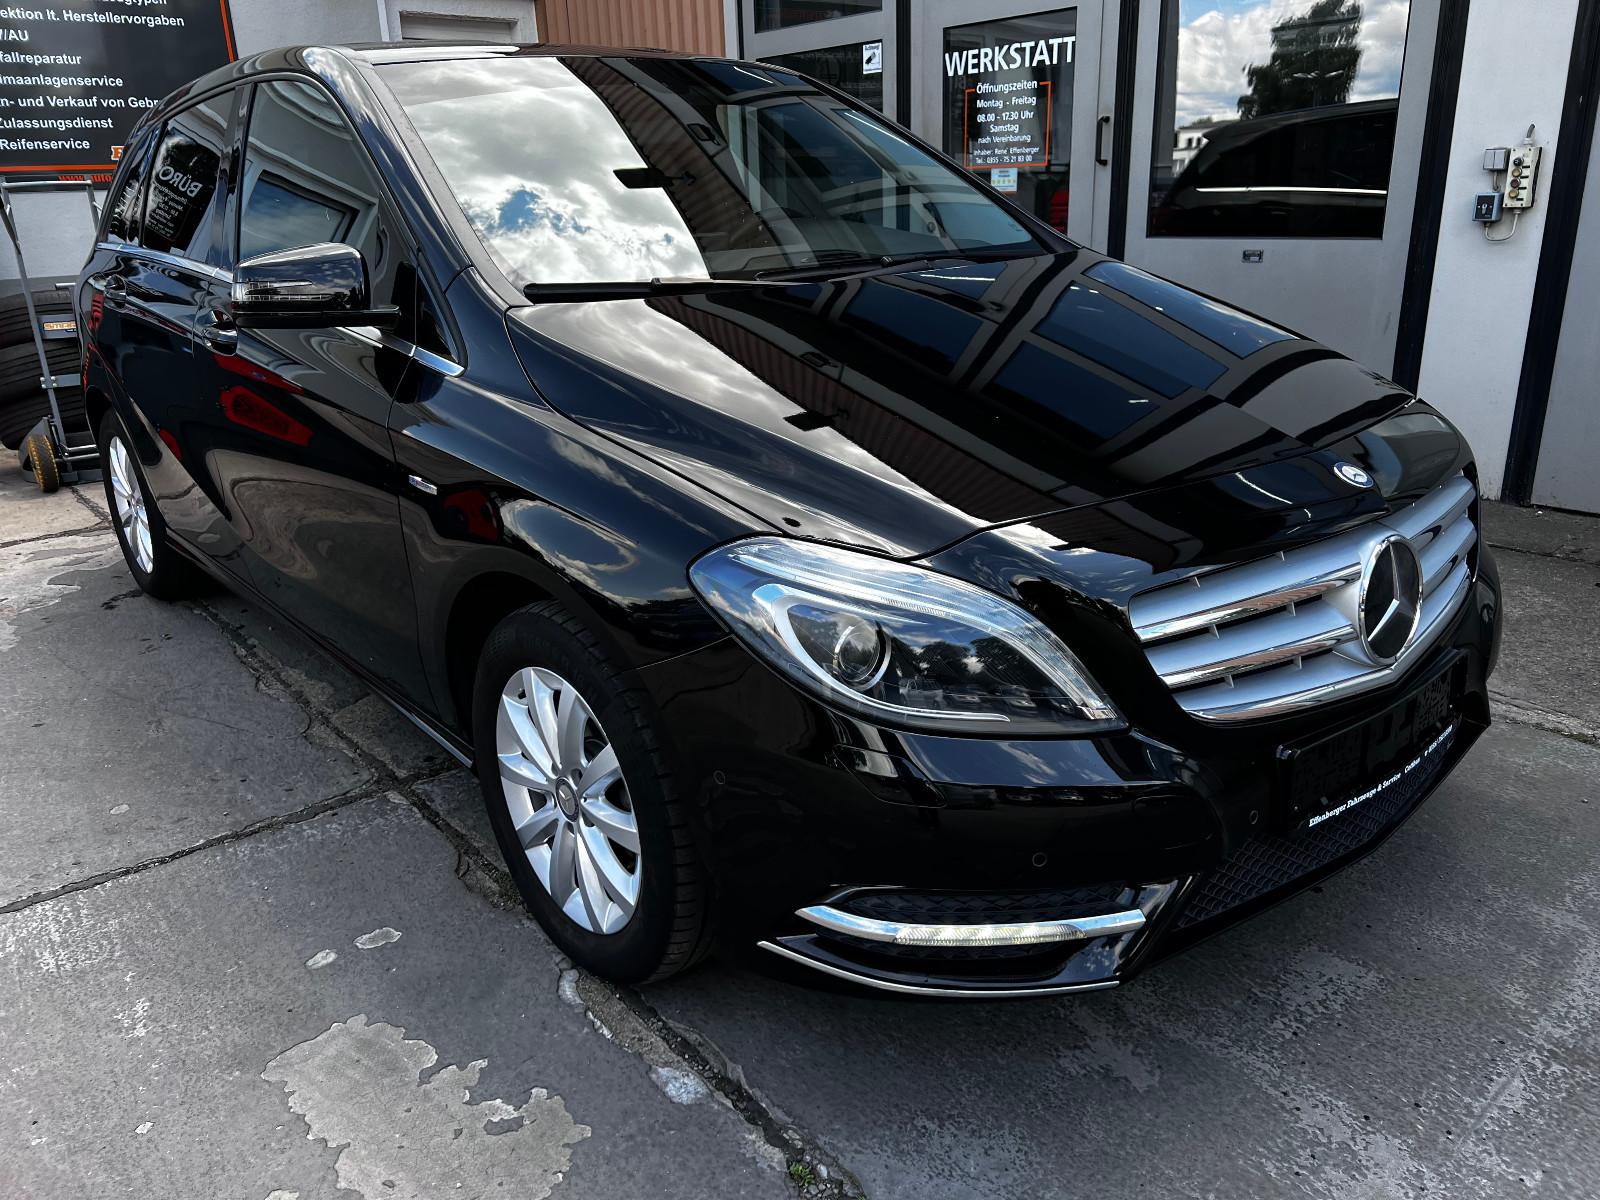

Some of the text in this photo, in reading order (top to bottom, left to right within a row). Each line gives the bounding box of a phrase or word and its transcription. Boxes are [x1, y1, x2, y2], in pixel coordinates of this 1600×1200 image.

[46, 9, 60, 21] lt.
[62, 9, 185, 28] Herstellervorgaben
[944, 35, 1076, 77] WERKSTATT
[976, 80, 1038, 95] Öffnungszeiten
[18, 95, 44, 108] und
[46, 95, 98, 108] Verkauf
[100, 99, 126, 109] von
[976, 99, 1004, 109] Montag
[1011, 96, 1037, 107] Freitag
[976, 113, 996, 123] 08.00
[1002, 111, 1019, 121] 17.30
[1020, 110, 1034, 119] Uhr
[989, 123, 1020, 133] Samstag
[0, 138, 91, 150] Reifenservice
[977, 134, 1032, 145] nach Vereinbarung
[1009, 146, 1040, 155] Effenberger
[1382, 772, 1402, 789] Service
